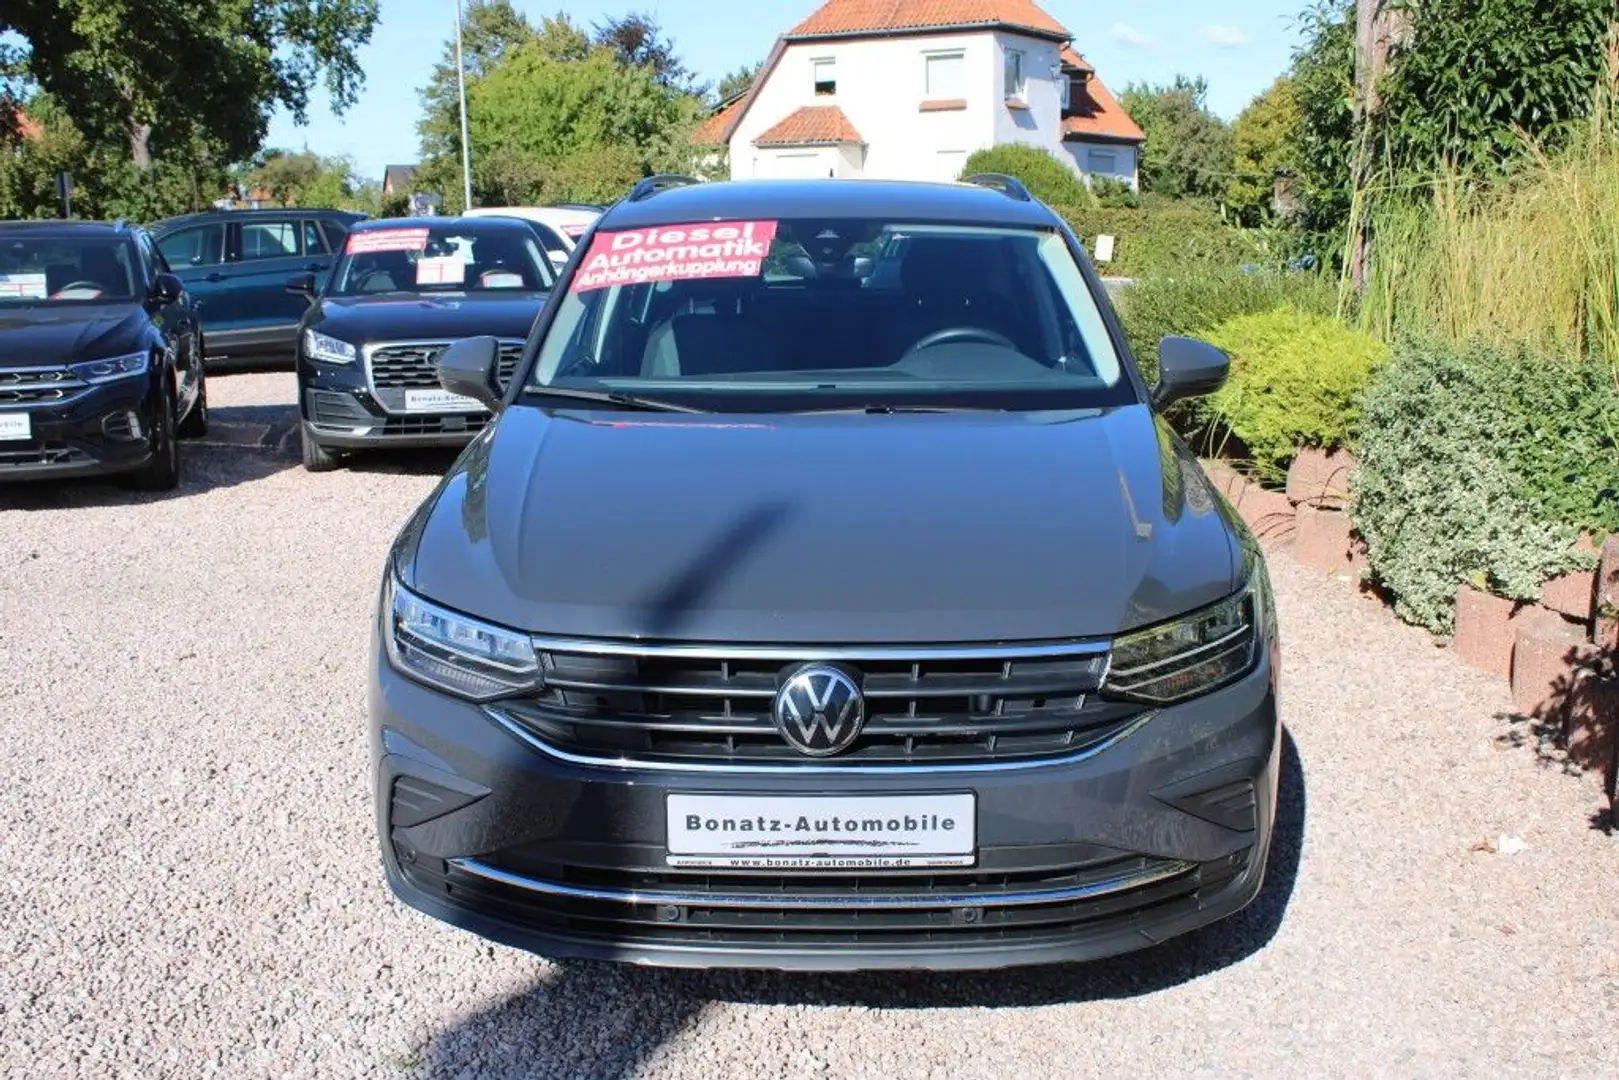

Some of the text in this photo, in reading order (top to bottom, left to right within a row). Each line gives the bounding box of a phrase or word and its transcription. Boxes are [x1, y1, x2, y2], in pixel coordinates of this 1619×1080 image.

[612, 222, 755, 250] Diesel
[585, 239, 764, 271] Automatik
[685, 814, 956, 832] Bonatz-Automobile
[730, 858, 911, 868] www.bonatz-automobile.de
